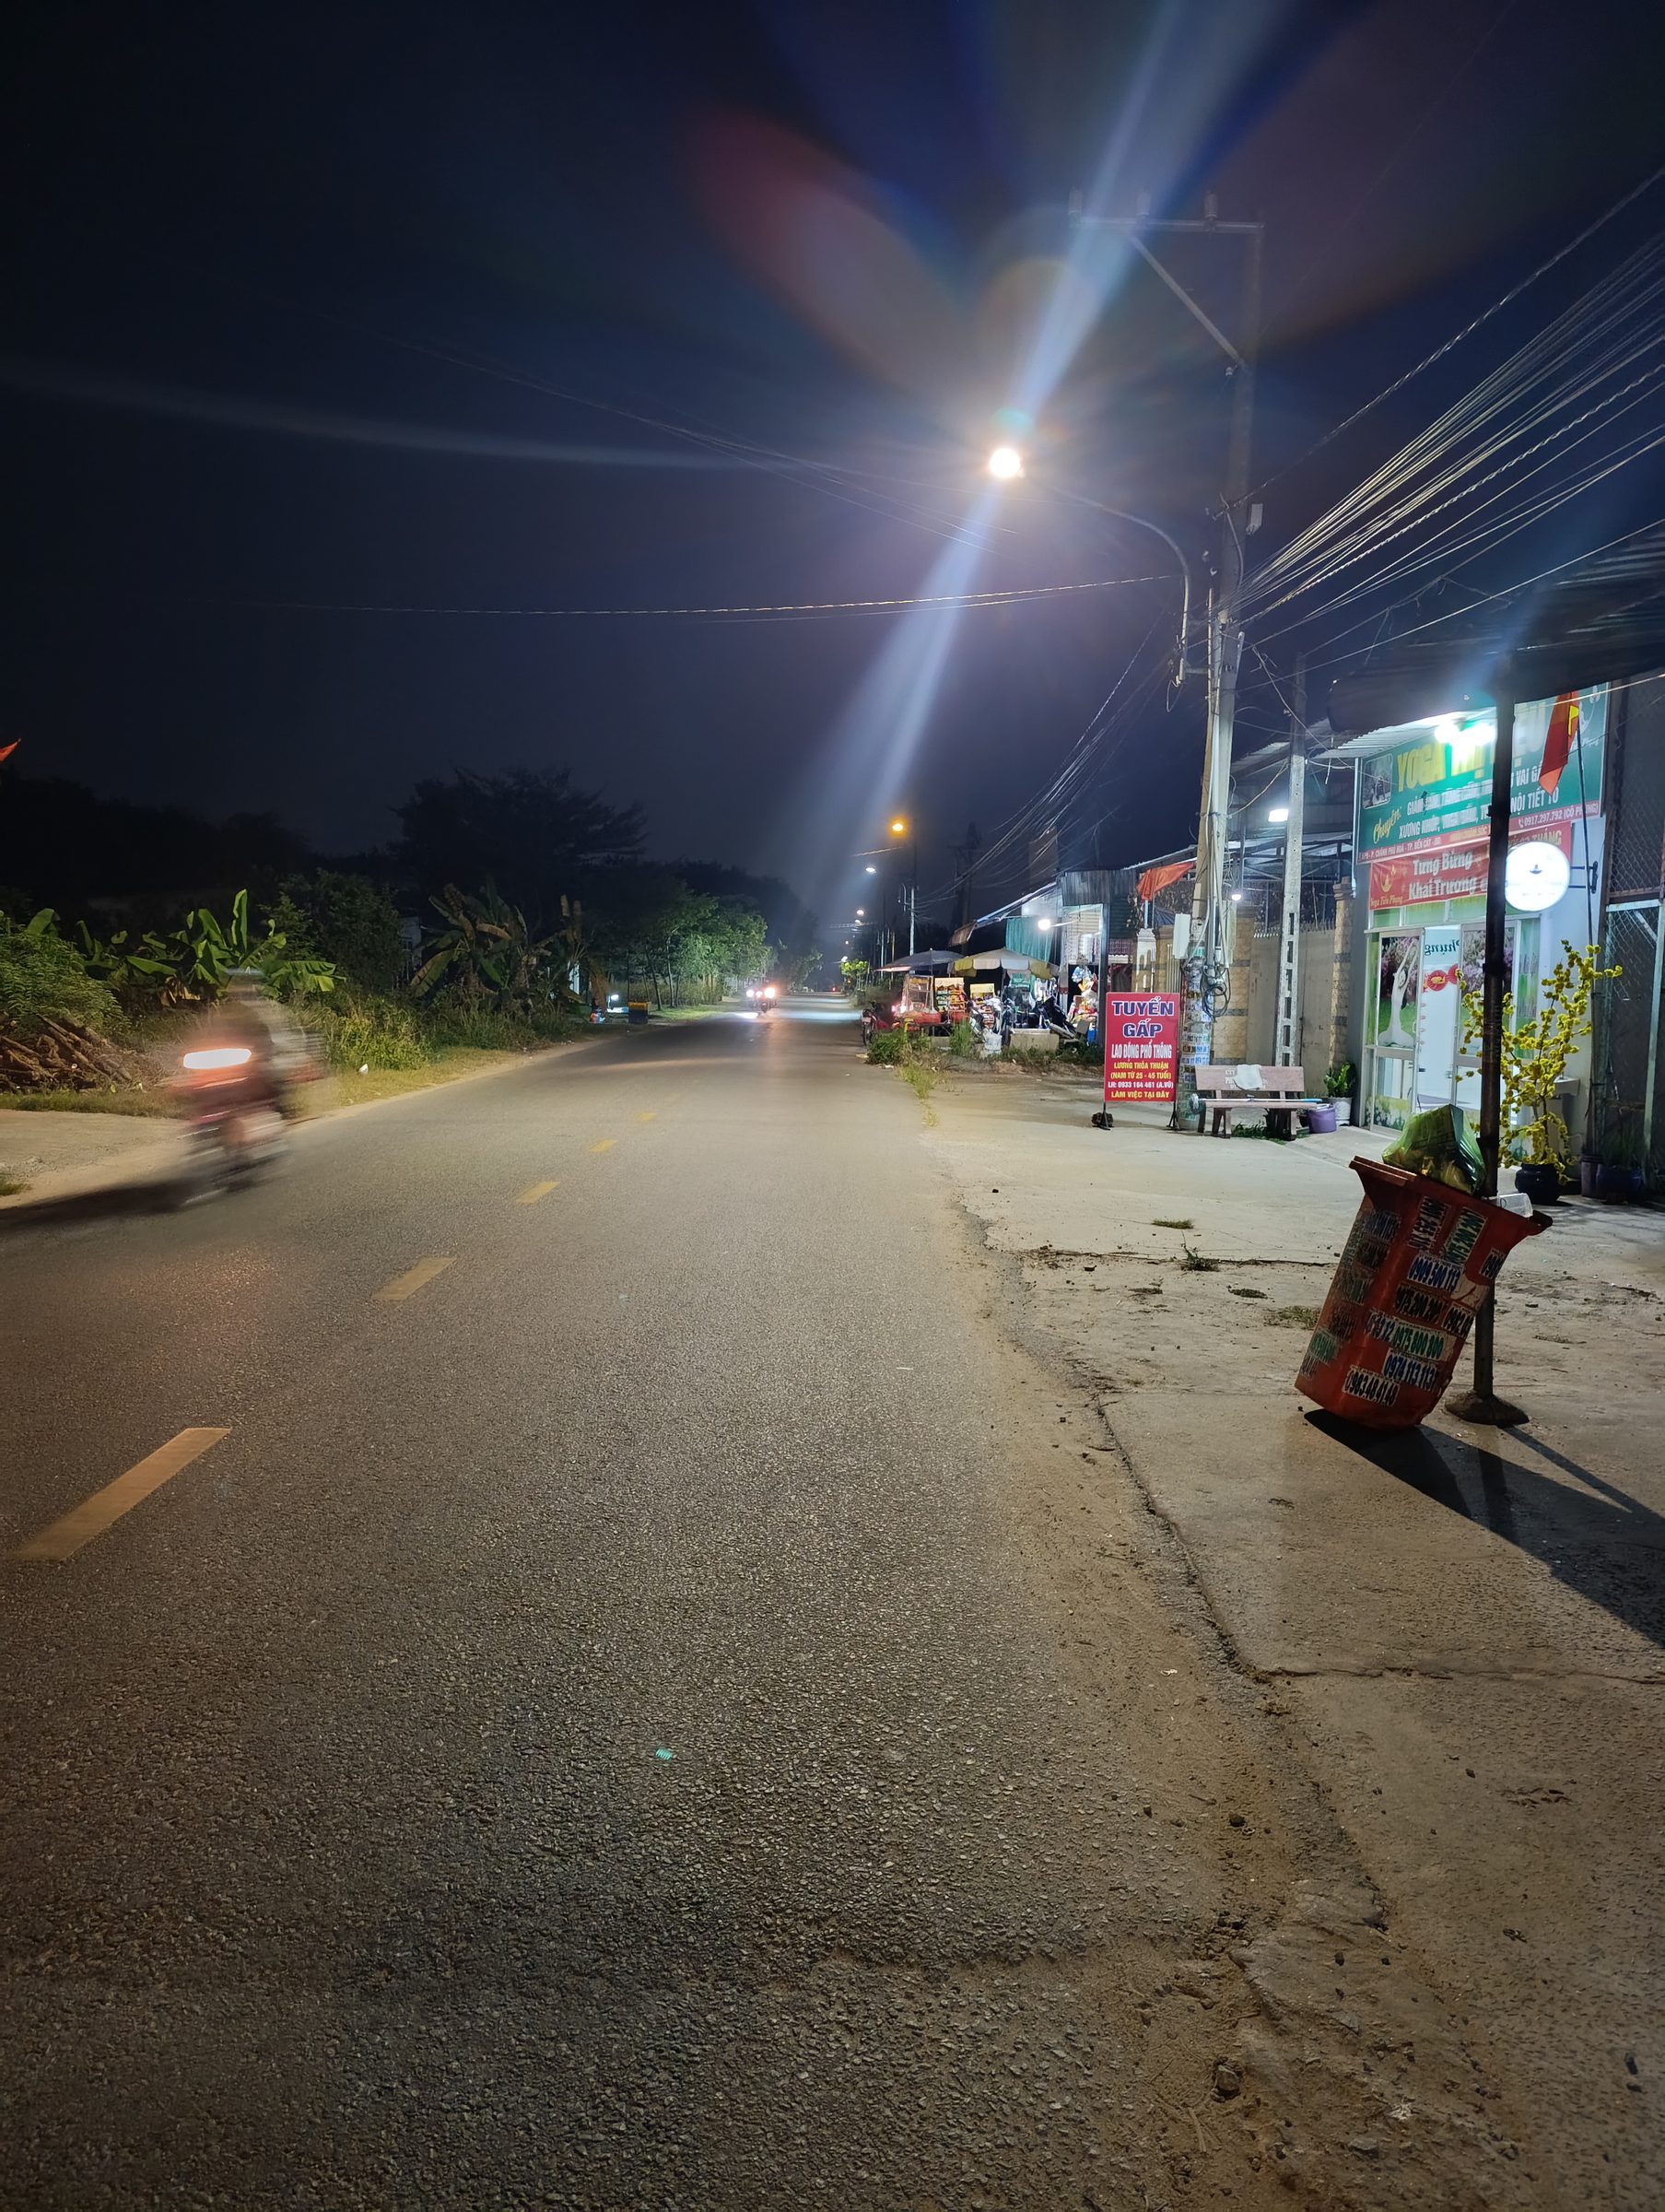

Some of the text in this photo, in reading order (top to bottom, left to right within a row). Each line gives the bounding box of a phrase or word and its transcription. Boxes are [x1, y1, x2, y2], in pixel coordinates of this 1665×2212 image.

[1123, 1018, 1163, 1038] GẤP
[1111, 1043, 1122, 1058] LAO
[1153, 1041, 1172, 1059] THÔNG
